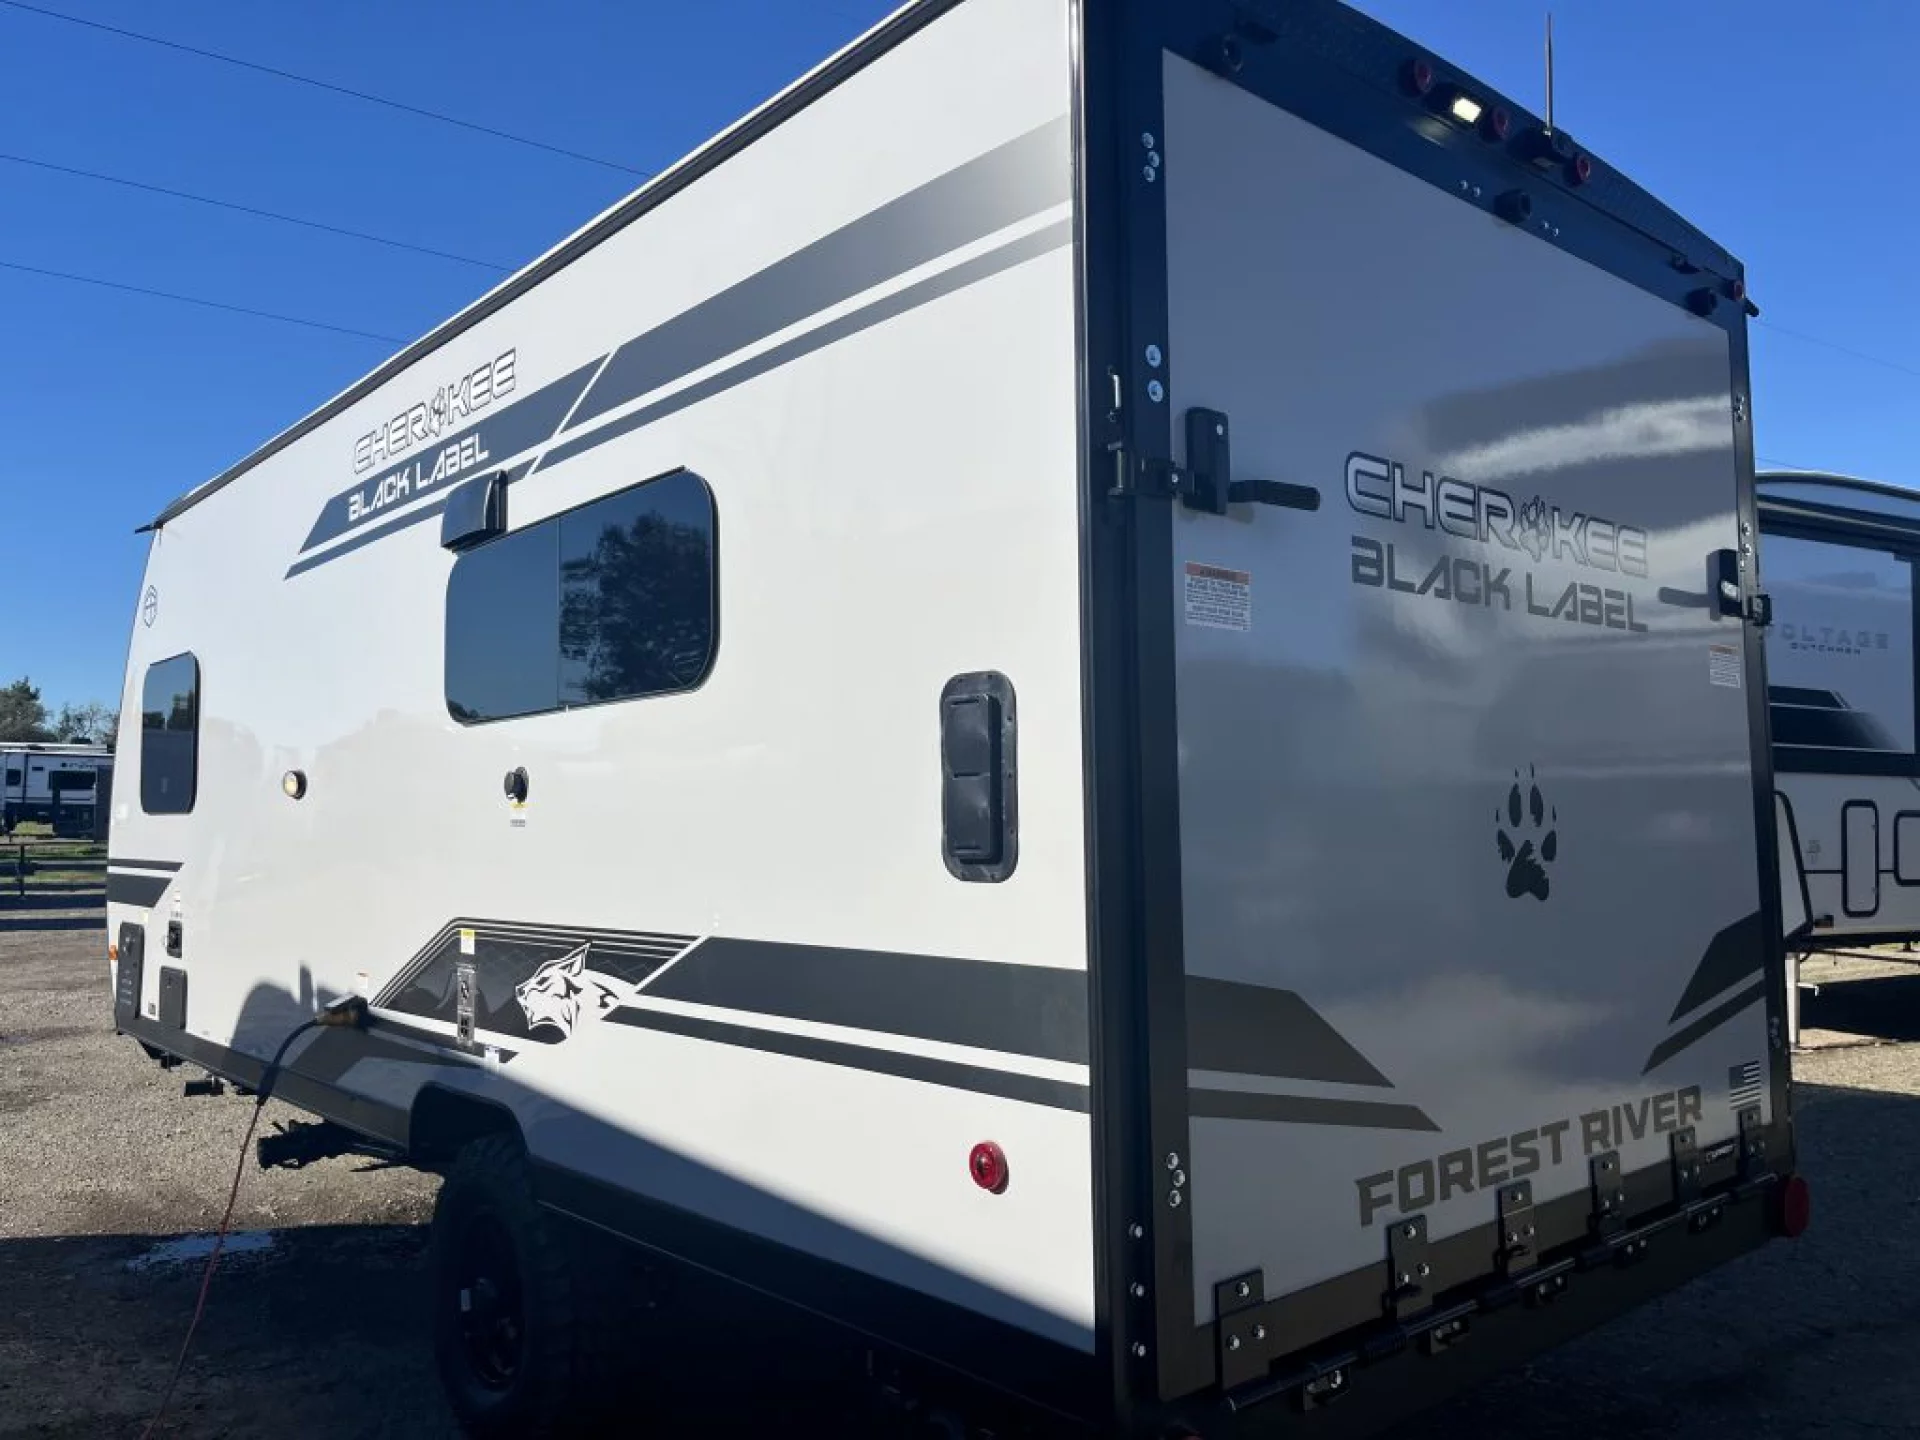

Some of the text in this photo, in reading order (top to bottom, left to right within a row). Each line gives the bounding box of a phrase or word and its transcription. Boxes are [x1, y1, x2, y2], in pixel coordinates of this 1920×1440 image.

[349, 433, 490, 522] BLACK LABEL
[1351, 535, 1649, 633] BLACK LABEL
[1354, 1084, 1704, 1227] FOREST RIVER
